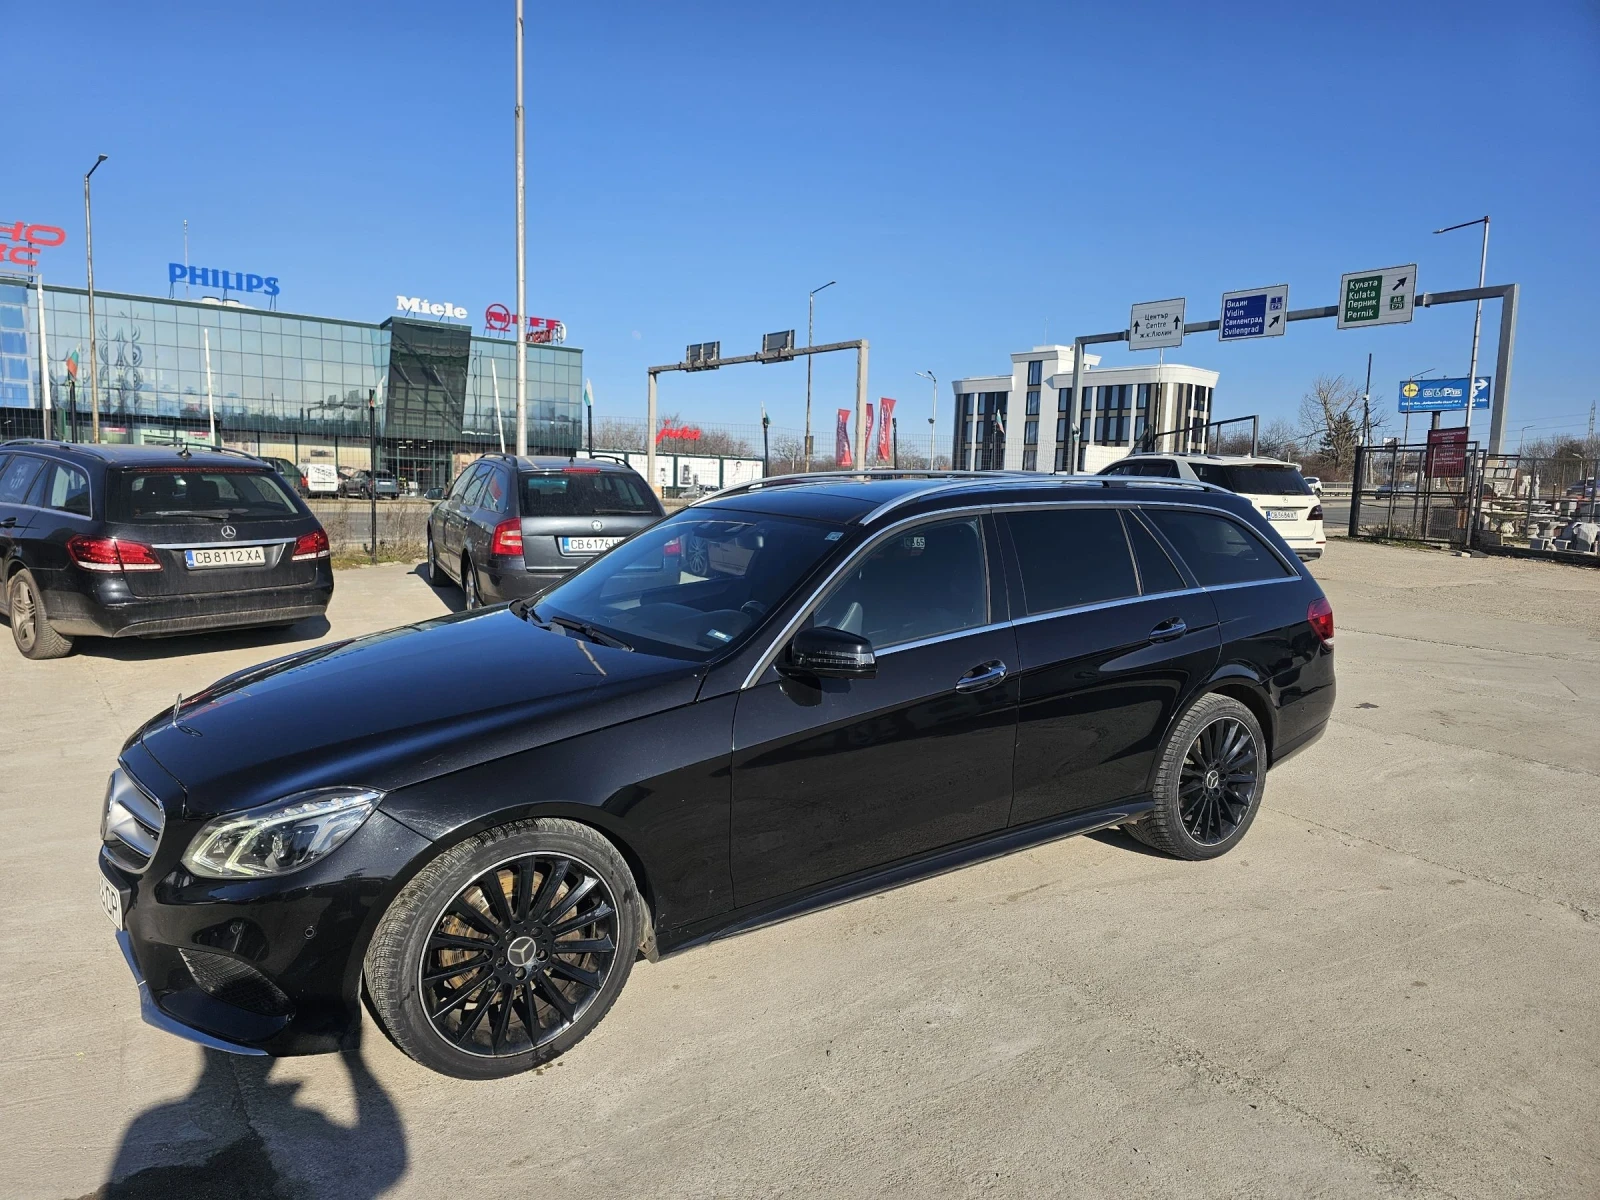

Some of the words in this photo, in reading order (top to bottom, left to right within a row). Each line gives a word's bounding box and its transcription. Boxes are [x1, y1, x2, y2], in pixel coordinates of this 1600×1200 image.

[169, 262, 280, 296] PHILIPS
[1349, 280, 1378, 290] Кулата
[1348, 290, 1376, 300] Kulata
[396, 295, 468, 319] Miele
[1226, 300, 1248, 308] Видин
[1347, 299, 1377, 309] Перник
[1144, 312, 1169, 321] Център
[1226, 309, 1244, 317] Vidin
[1347, 309, 1374, 319] Pernik
[1145, 321, 1167, 329] Centre
[1225, 316, 1263, 326] Свиленград
[1224, 325, 1260, 336] Svilengrad
[570, 539, 585, 550] CB
[587, 539, 610, 549] 6176
[195, 552, 212, 564] CB
[214, 550, 244, 562] 8112
[245, 549, 262, 561] XA
